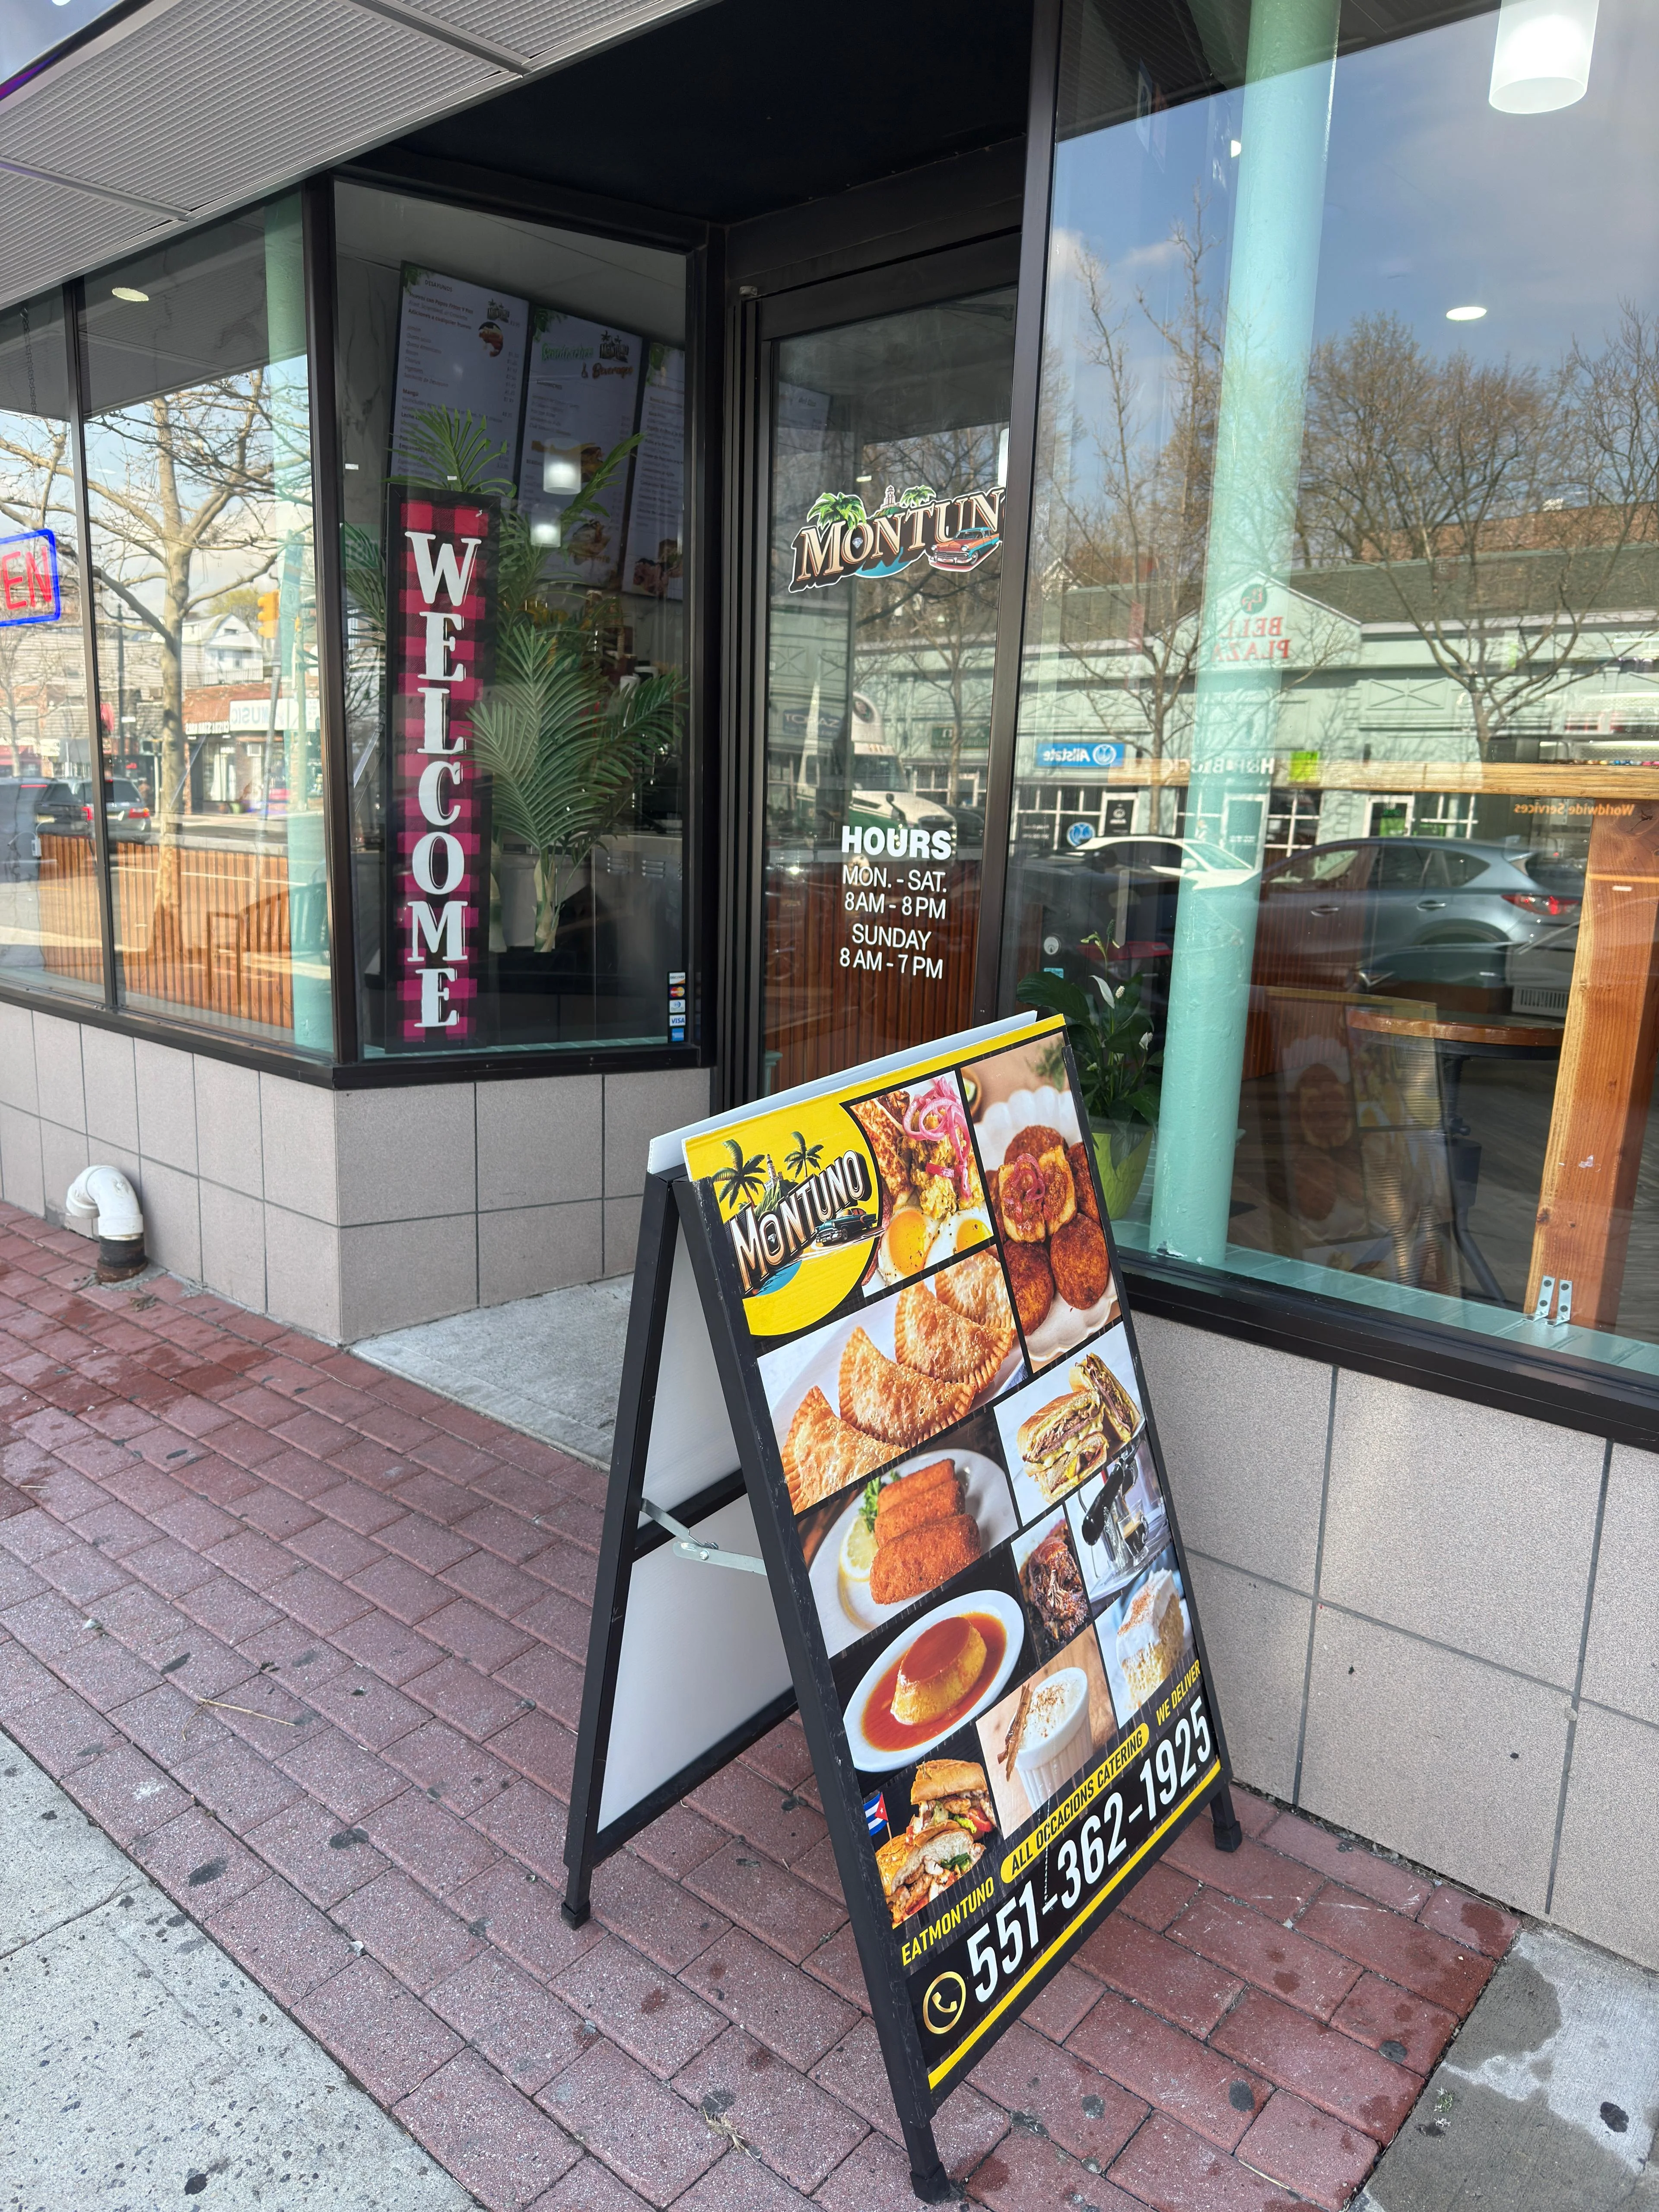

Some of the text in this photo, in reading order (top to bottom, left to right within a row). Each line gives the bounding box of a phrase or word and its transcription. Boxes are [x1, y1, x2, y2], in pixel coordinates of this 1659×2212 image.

[0, 546, 52, 610] EN
[793, 487, 1005, 587] MONTUN
[785, 713, 840, 728] TOAZ
[405, 531, 482, 1027] WELCOME
[842, 825, 952, 860] HOURS
[842, 865, 891, 889] MON.
[908, 869, 947, 893] SAT.
[852, 923, 932, 951] SUNDAY
[728, 1148, 872, 1295] MONTUNO
[901, 1659, 1201, 1968] EATMONTUNO ALL OCCACIONS CATERING WE DELIVER
[966, 1695, 1211, 2005] 551-362-1925
